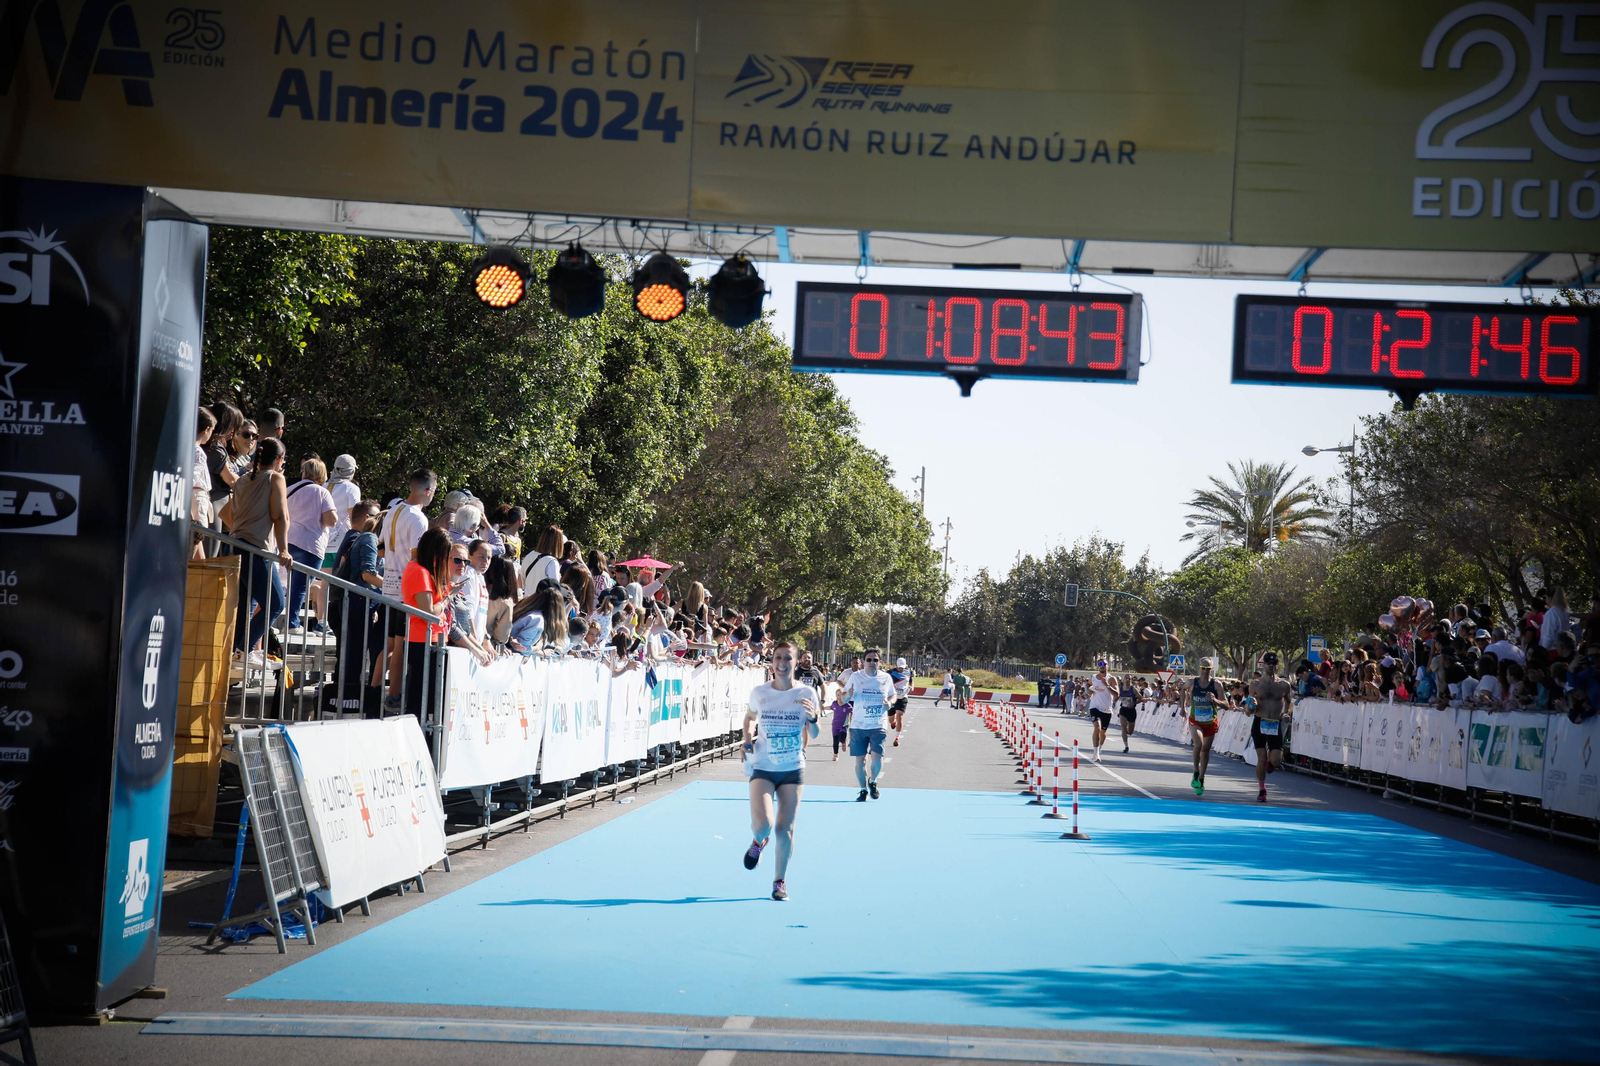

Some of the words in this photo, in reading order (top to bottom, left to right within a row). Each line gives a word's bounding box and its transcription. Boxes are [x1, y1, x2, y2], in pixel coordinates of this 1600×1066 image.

[164, 7, 225, 51] 25
[273, 15, 436, 65] Medio
[463, 28, 686, 81] Maratón
[163, 52, 225, 68] EDICIÓN
[829, 60, 915, 80] RFEA
[819, 82, 905, 97] SERIES
[267, 67, 506, 133] Almería
[519, 84, 684, 144] 2024
[811, 98, 865, 111] RUTA
[870, 101, 953, 115] RUNNING
[719, 120, 850, 153] RAMÓN
[866, 130, 950, 157] RUIZ
[964, 132, 1138, 166] ANDÚJAR
[7, 681, 27, 690] center
[134, 717, 162, 745] ALMERÍA
[141, 744, 156, 759] CIUDAD
[770, 736, 800, 749] 5193
